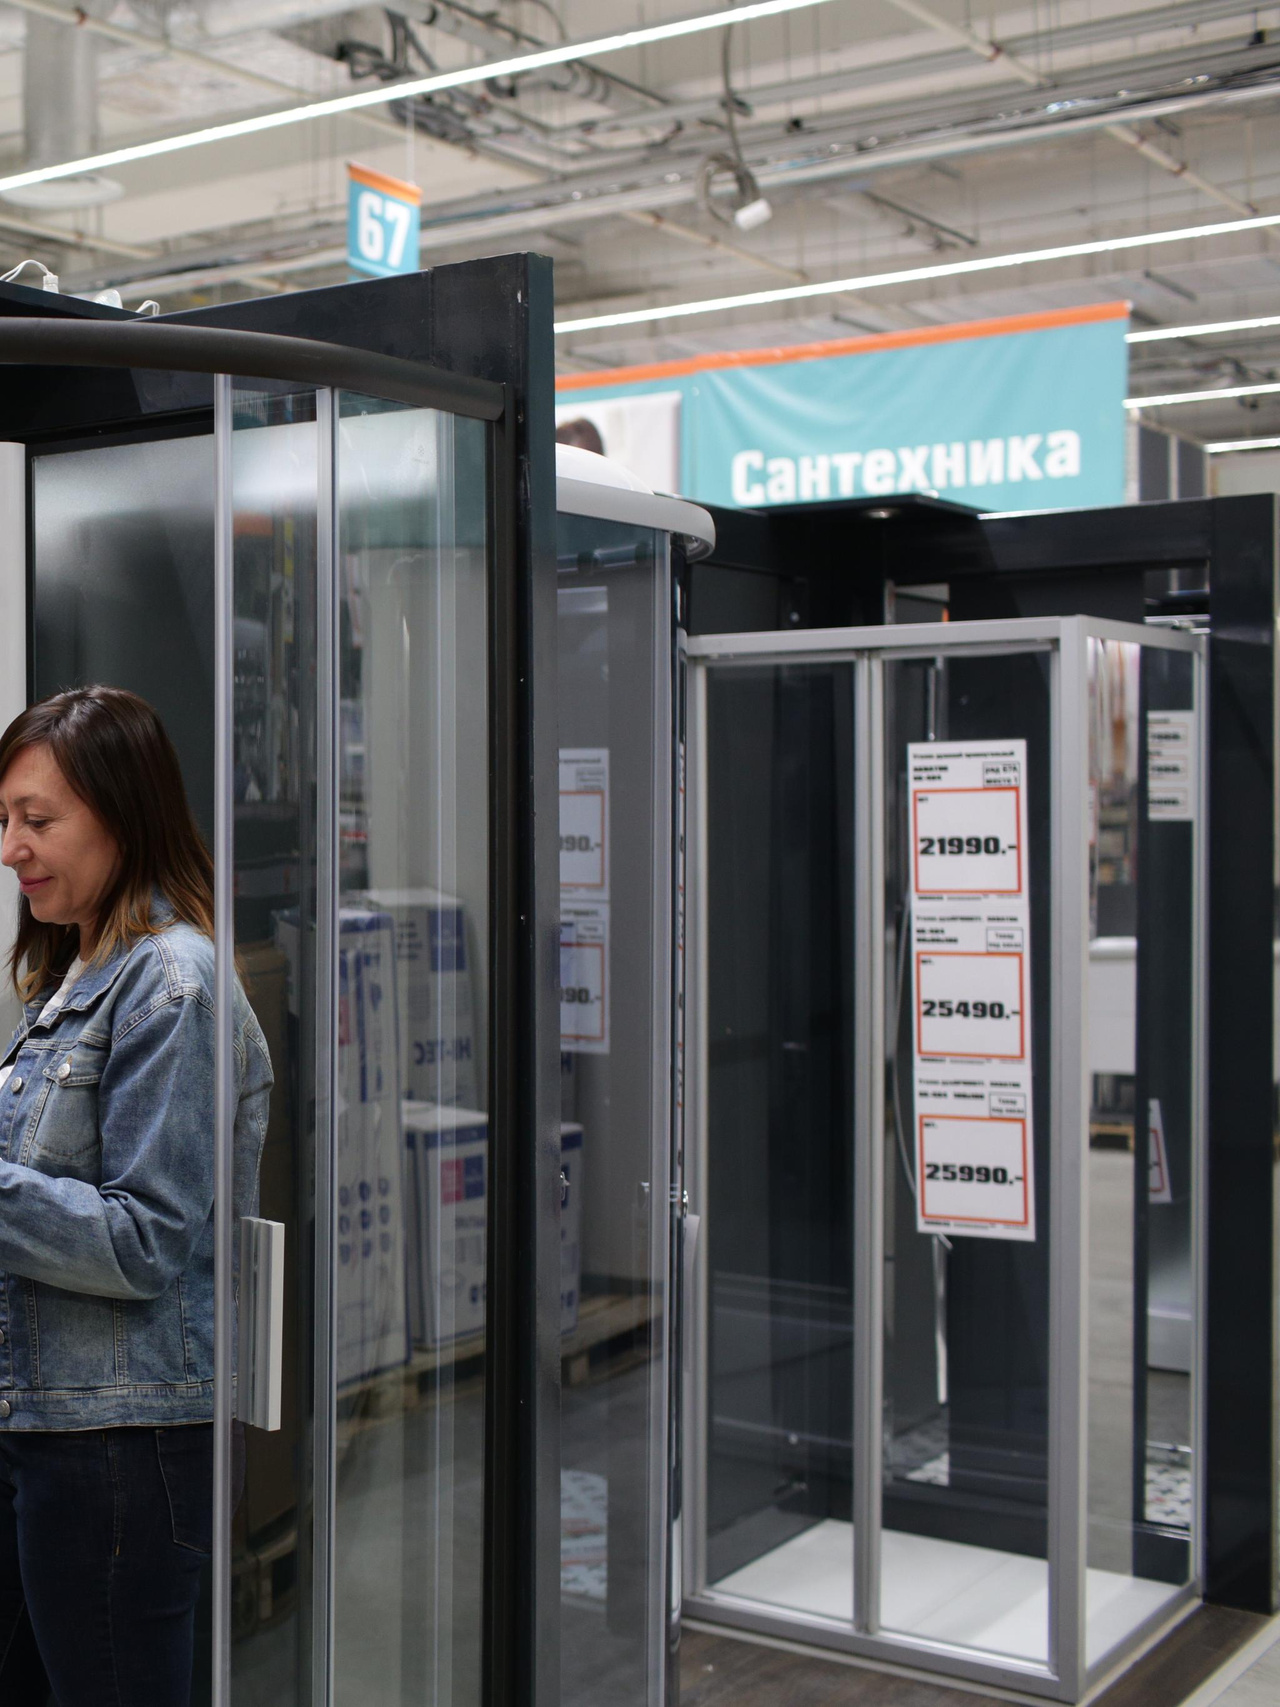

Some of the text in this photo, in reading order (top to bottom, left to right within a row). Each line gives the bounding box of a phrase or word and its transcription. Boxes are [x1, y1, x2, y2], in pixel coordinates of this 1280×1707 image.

[358, 191, 411, 268] 67
[731, 429, 1081, 506] Сантехника
[919, 836, 1018, 856] 21990.-
[922, 1000, 1020, 1020] 25490.-
[925, 1163, 1023, 1186] 25990.-
